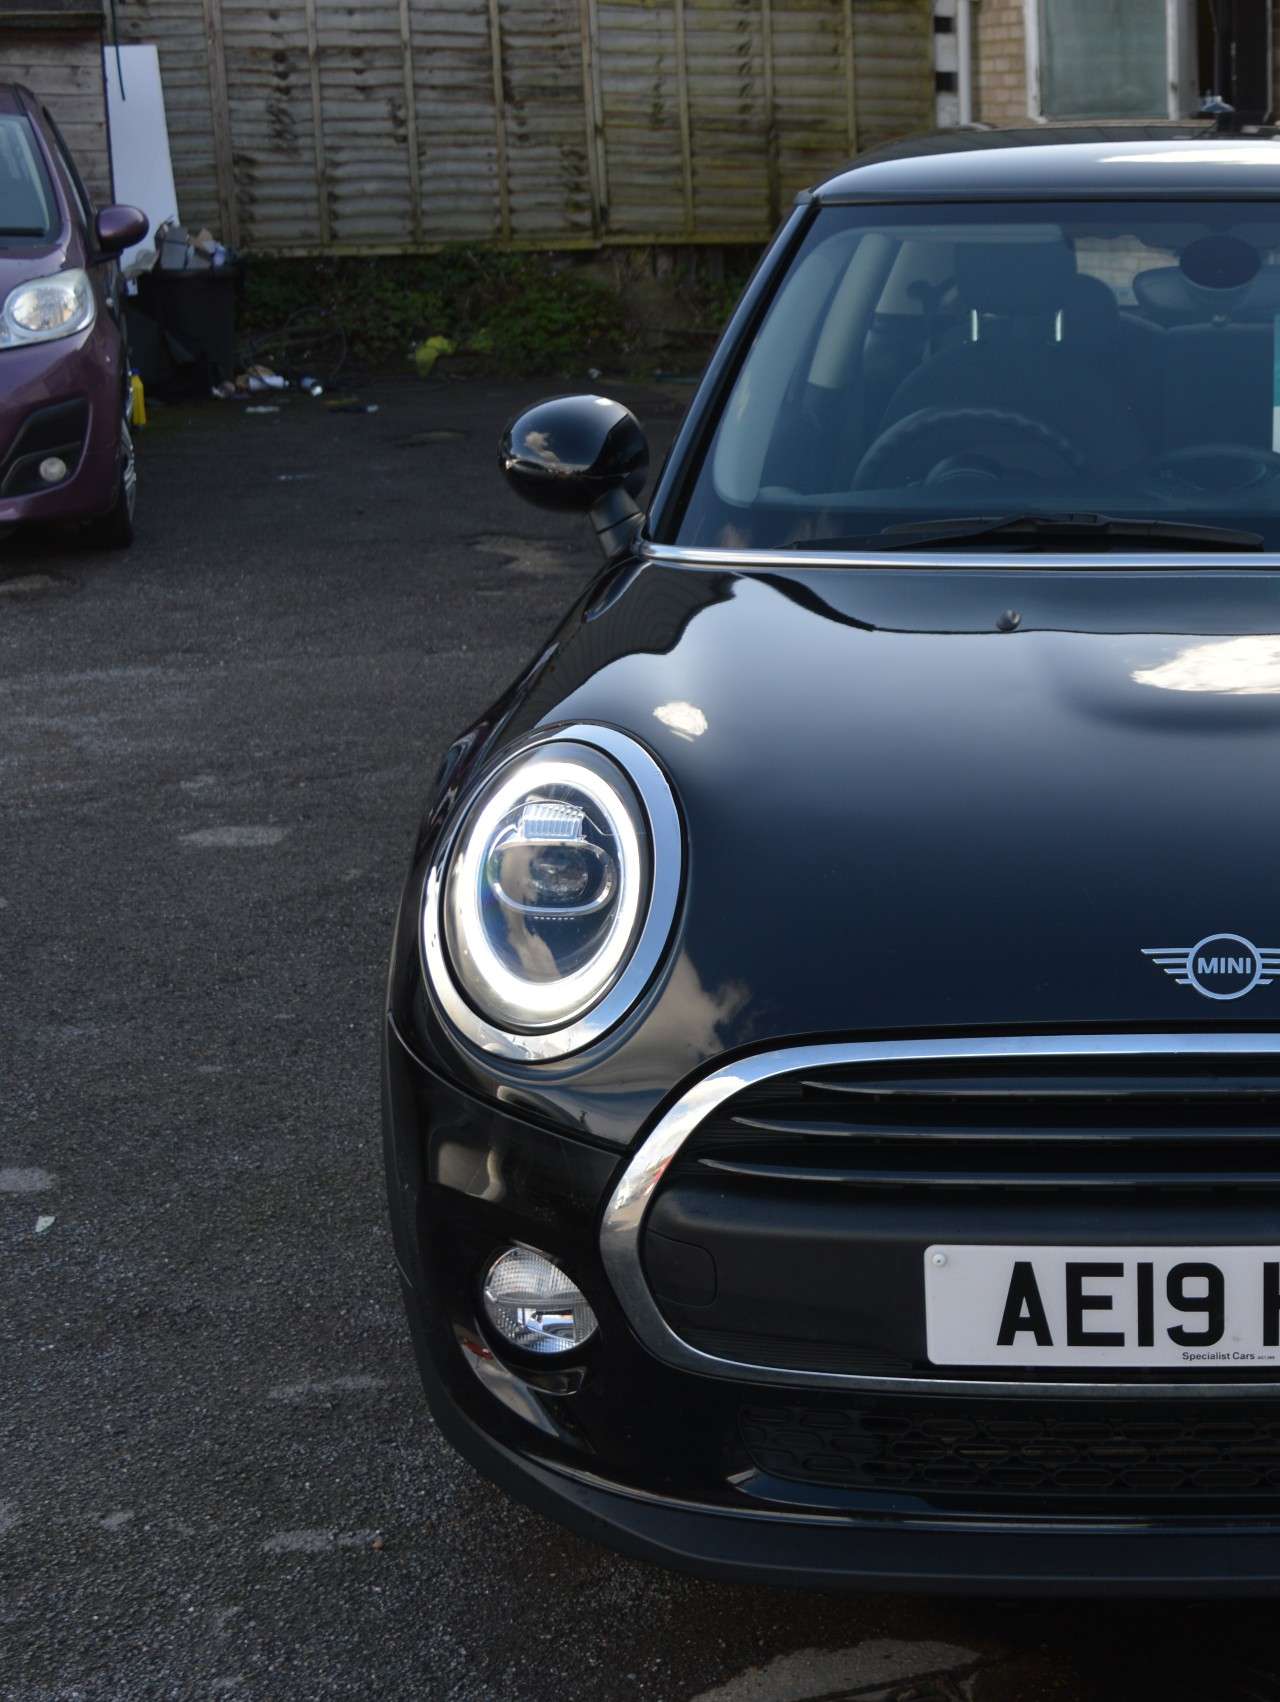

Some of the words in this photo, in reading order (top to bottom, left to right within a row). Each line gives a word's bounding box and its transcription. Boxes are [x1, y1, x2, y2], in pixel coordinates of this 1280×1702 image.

[1198, 957, 1252, 974] MINI
[1182, 1351, 1231, 1361] Specialist
[1232, 1351, 1256, 1361] Cars
